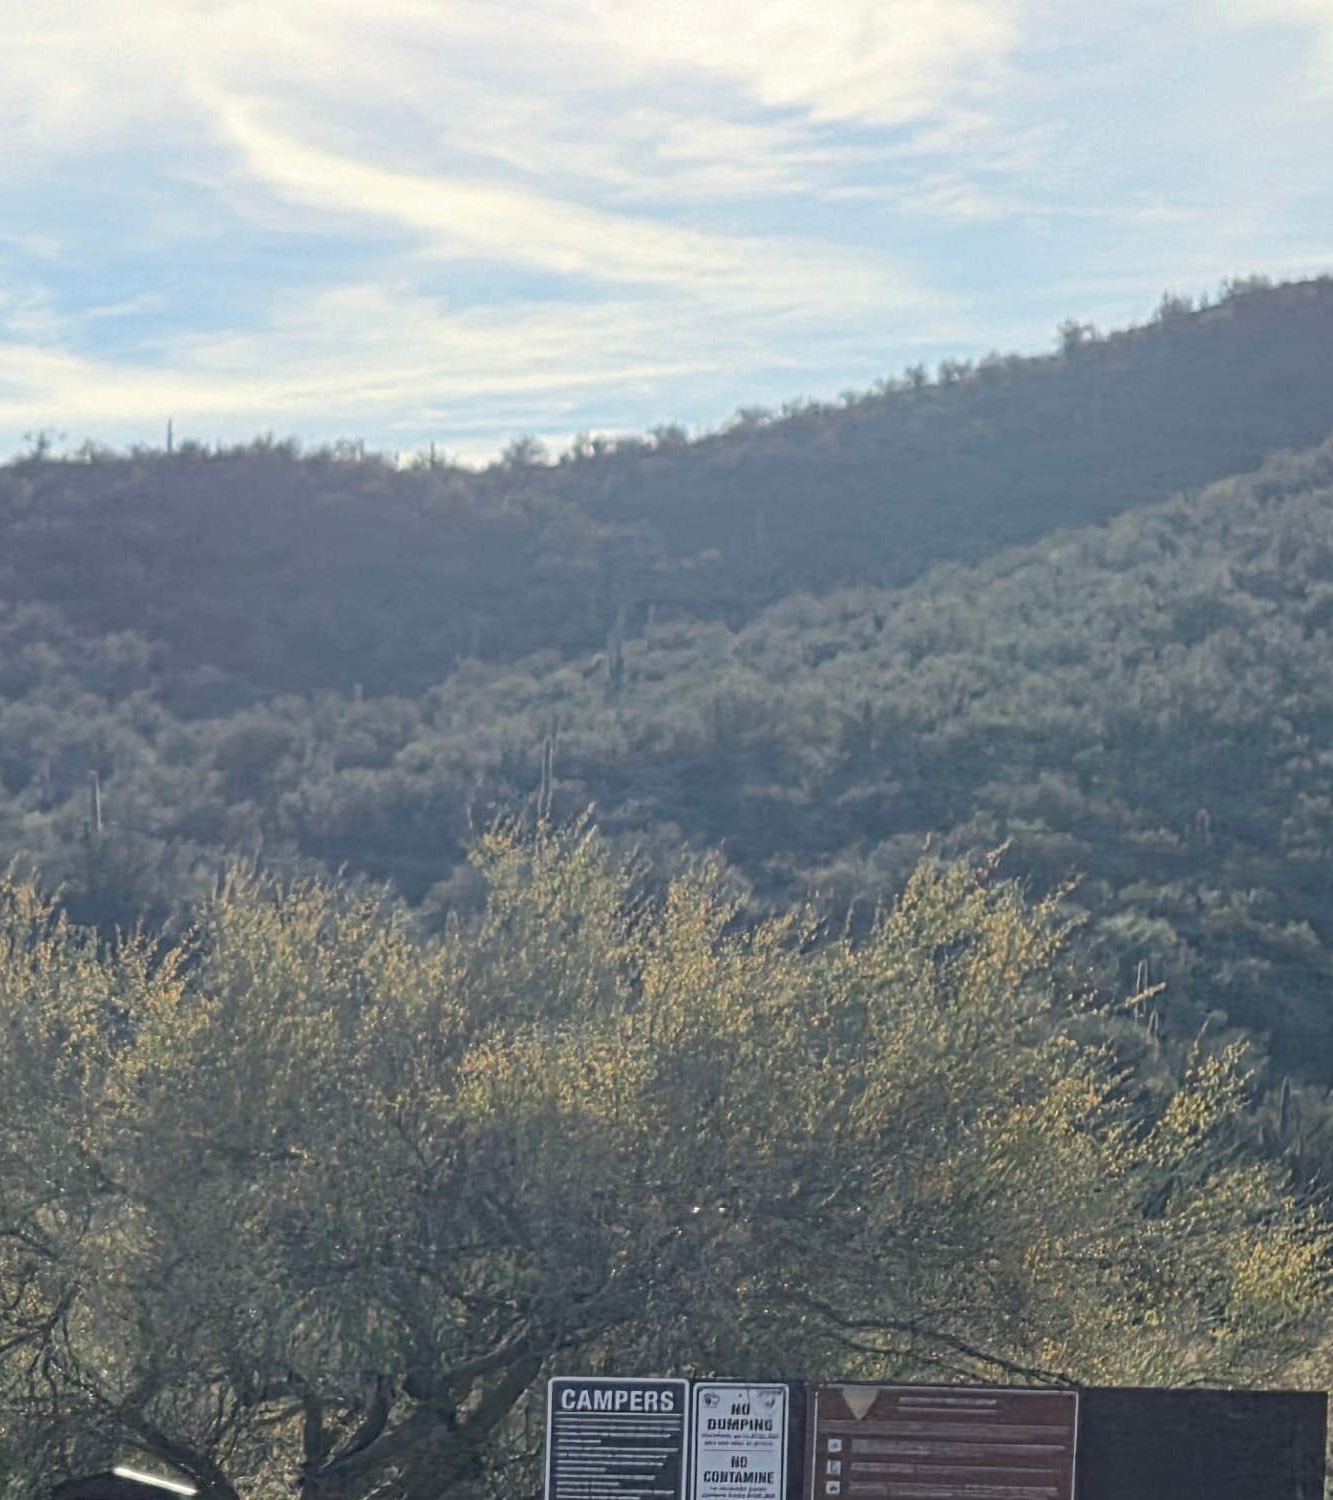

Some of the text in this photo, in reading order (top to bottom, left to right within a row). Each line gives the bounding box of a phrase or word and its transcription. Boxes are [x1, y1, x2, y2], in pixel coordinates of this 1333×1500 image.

[561, 1388, 674, 1411] CAMPERS
[730, 1403, 750, 1415] NO
[707, 1418, 773, 1431] DUMPING
[730, 1455, 748, 1468] NO
[703, 1470, 774, 1483] CONTAMINE
